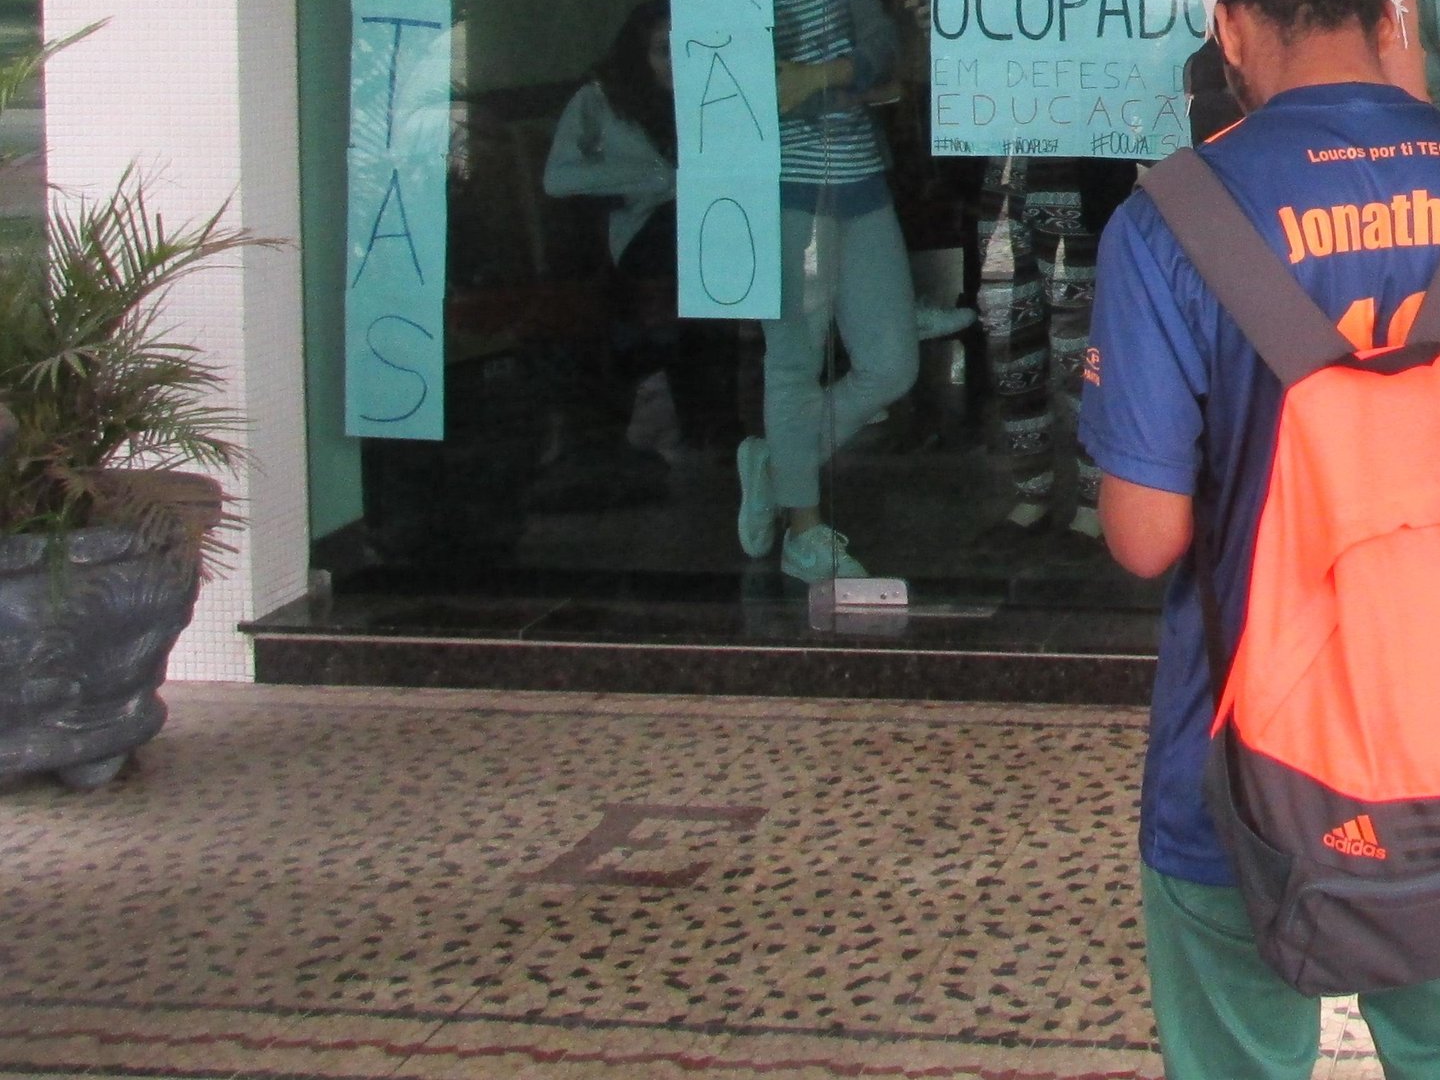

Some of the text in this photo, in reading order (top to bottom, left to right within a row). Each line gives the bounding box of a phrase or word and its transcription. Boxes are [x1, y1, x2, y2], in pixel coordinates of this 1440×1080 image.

[934, 58, 978, 88] EM
[1006, 59, 1147, 90] DEFESA
[1307, 146, 1366, 163] Loucos
[1368, 144, 1396, 161] por
[1400, 140, 1413, 156] ti
[1323, 833, 1387, 860] adidas
